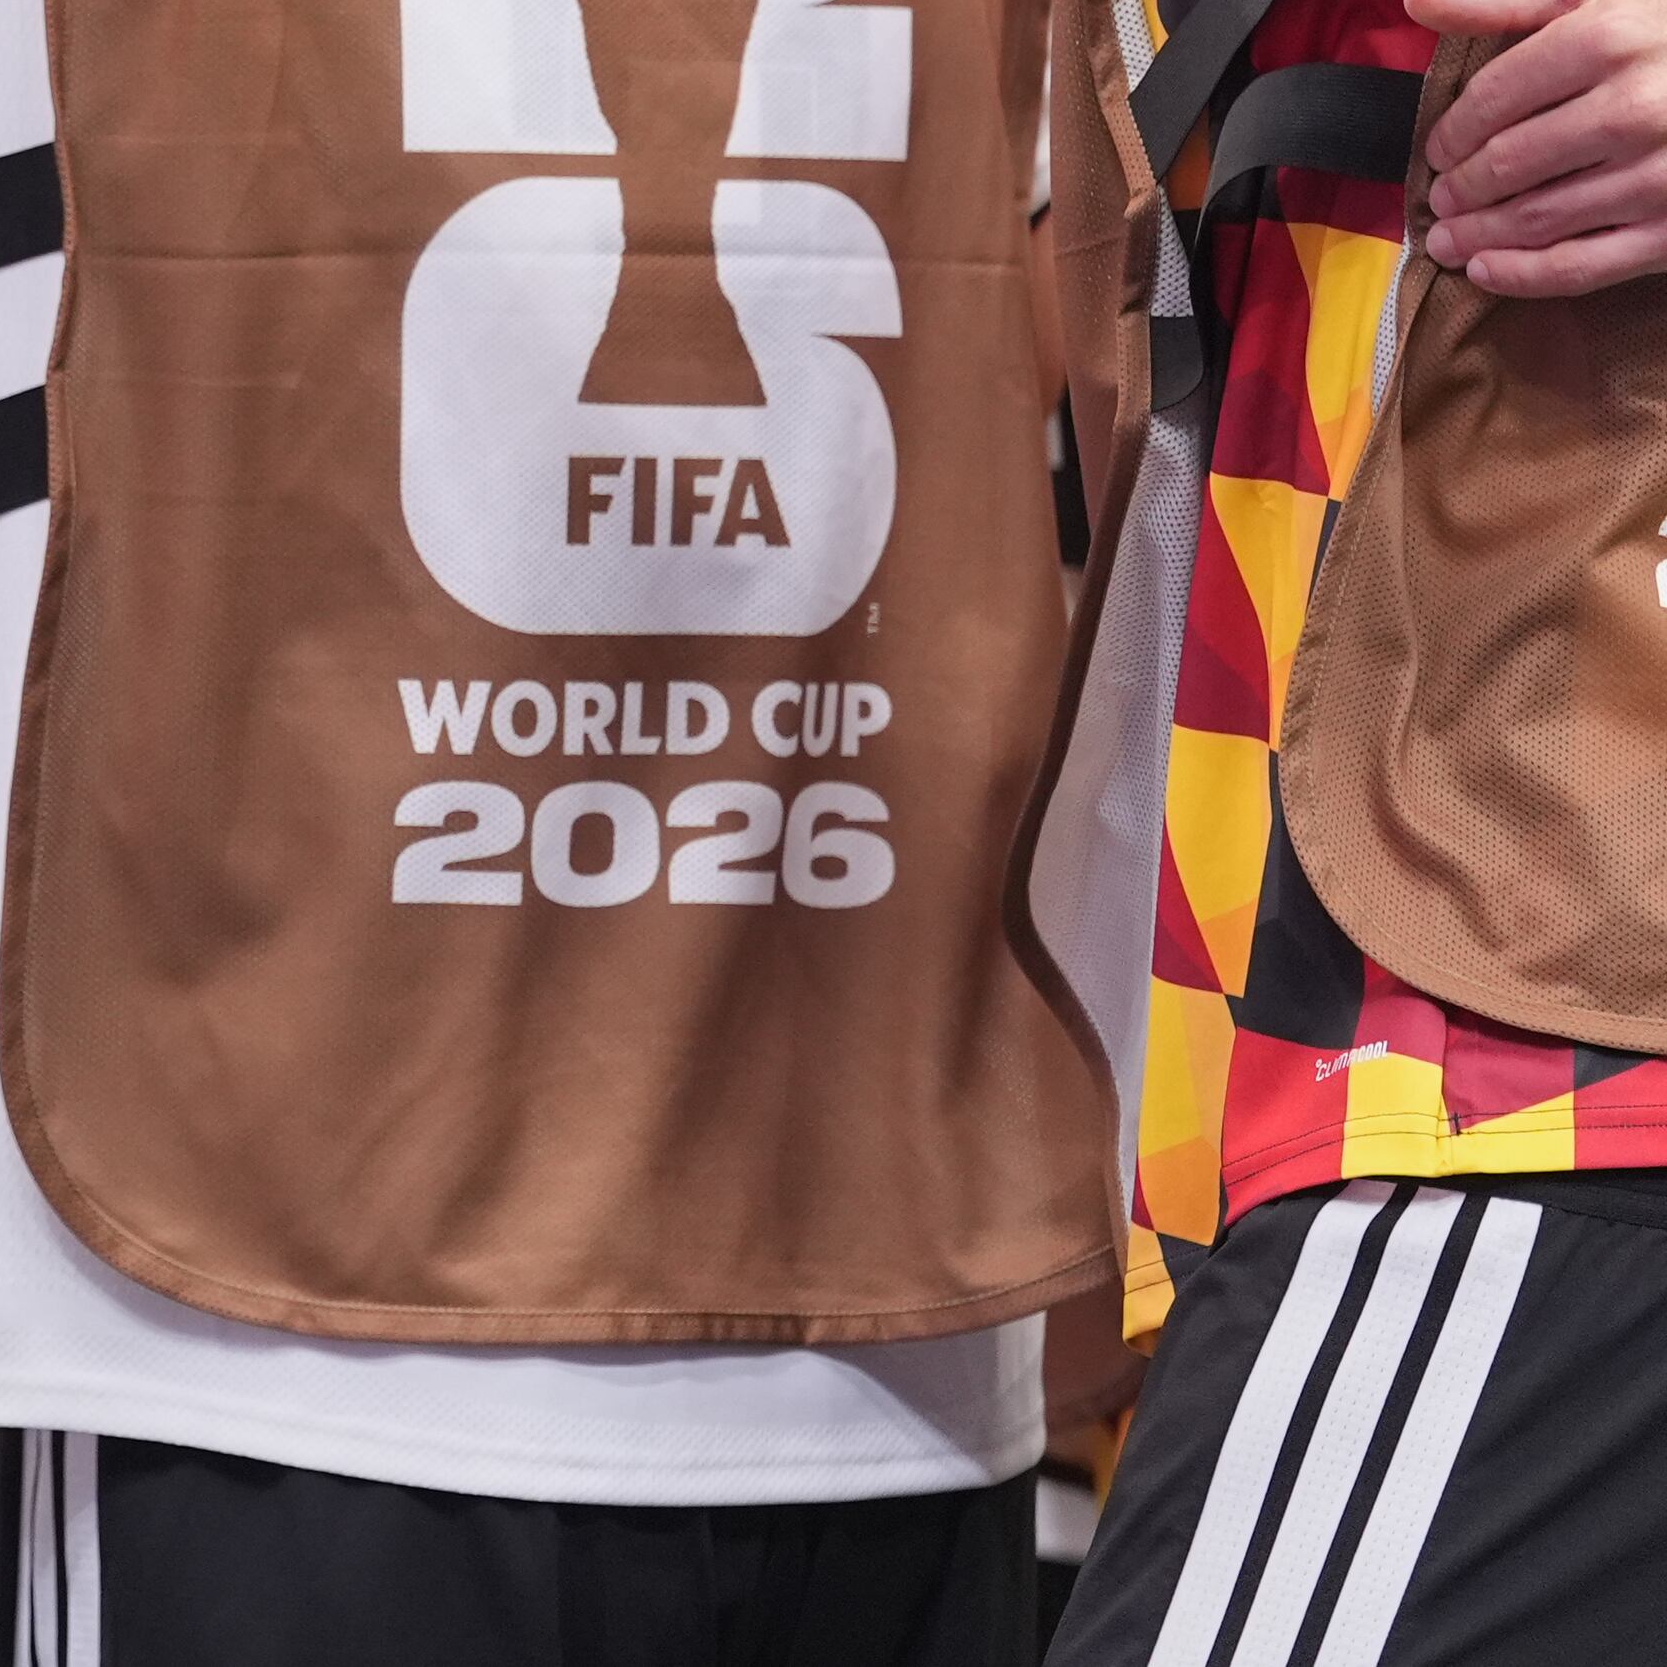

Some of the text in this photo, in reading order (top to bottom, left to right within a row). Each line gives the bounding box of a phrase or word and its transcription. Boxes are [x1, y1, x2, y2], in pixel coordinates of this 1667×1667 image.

[566, 456, 791, 547] FIFA
[396, 677, 893, 758] WORLD CUP
[391, 778, 897, 908] 2026
